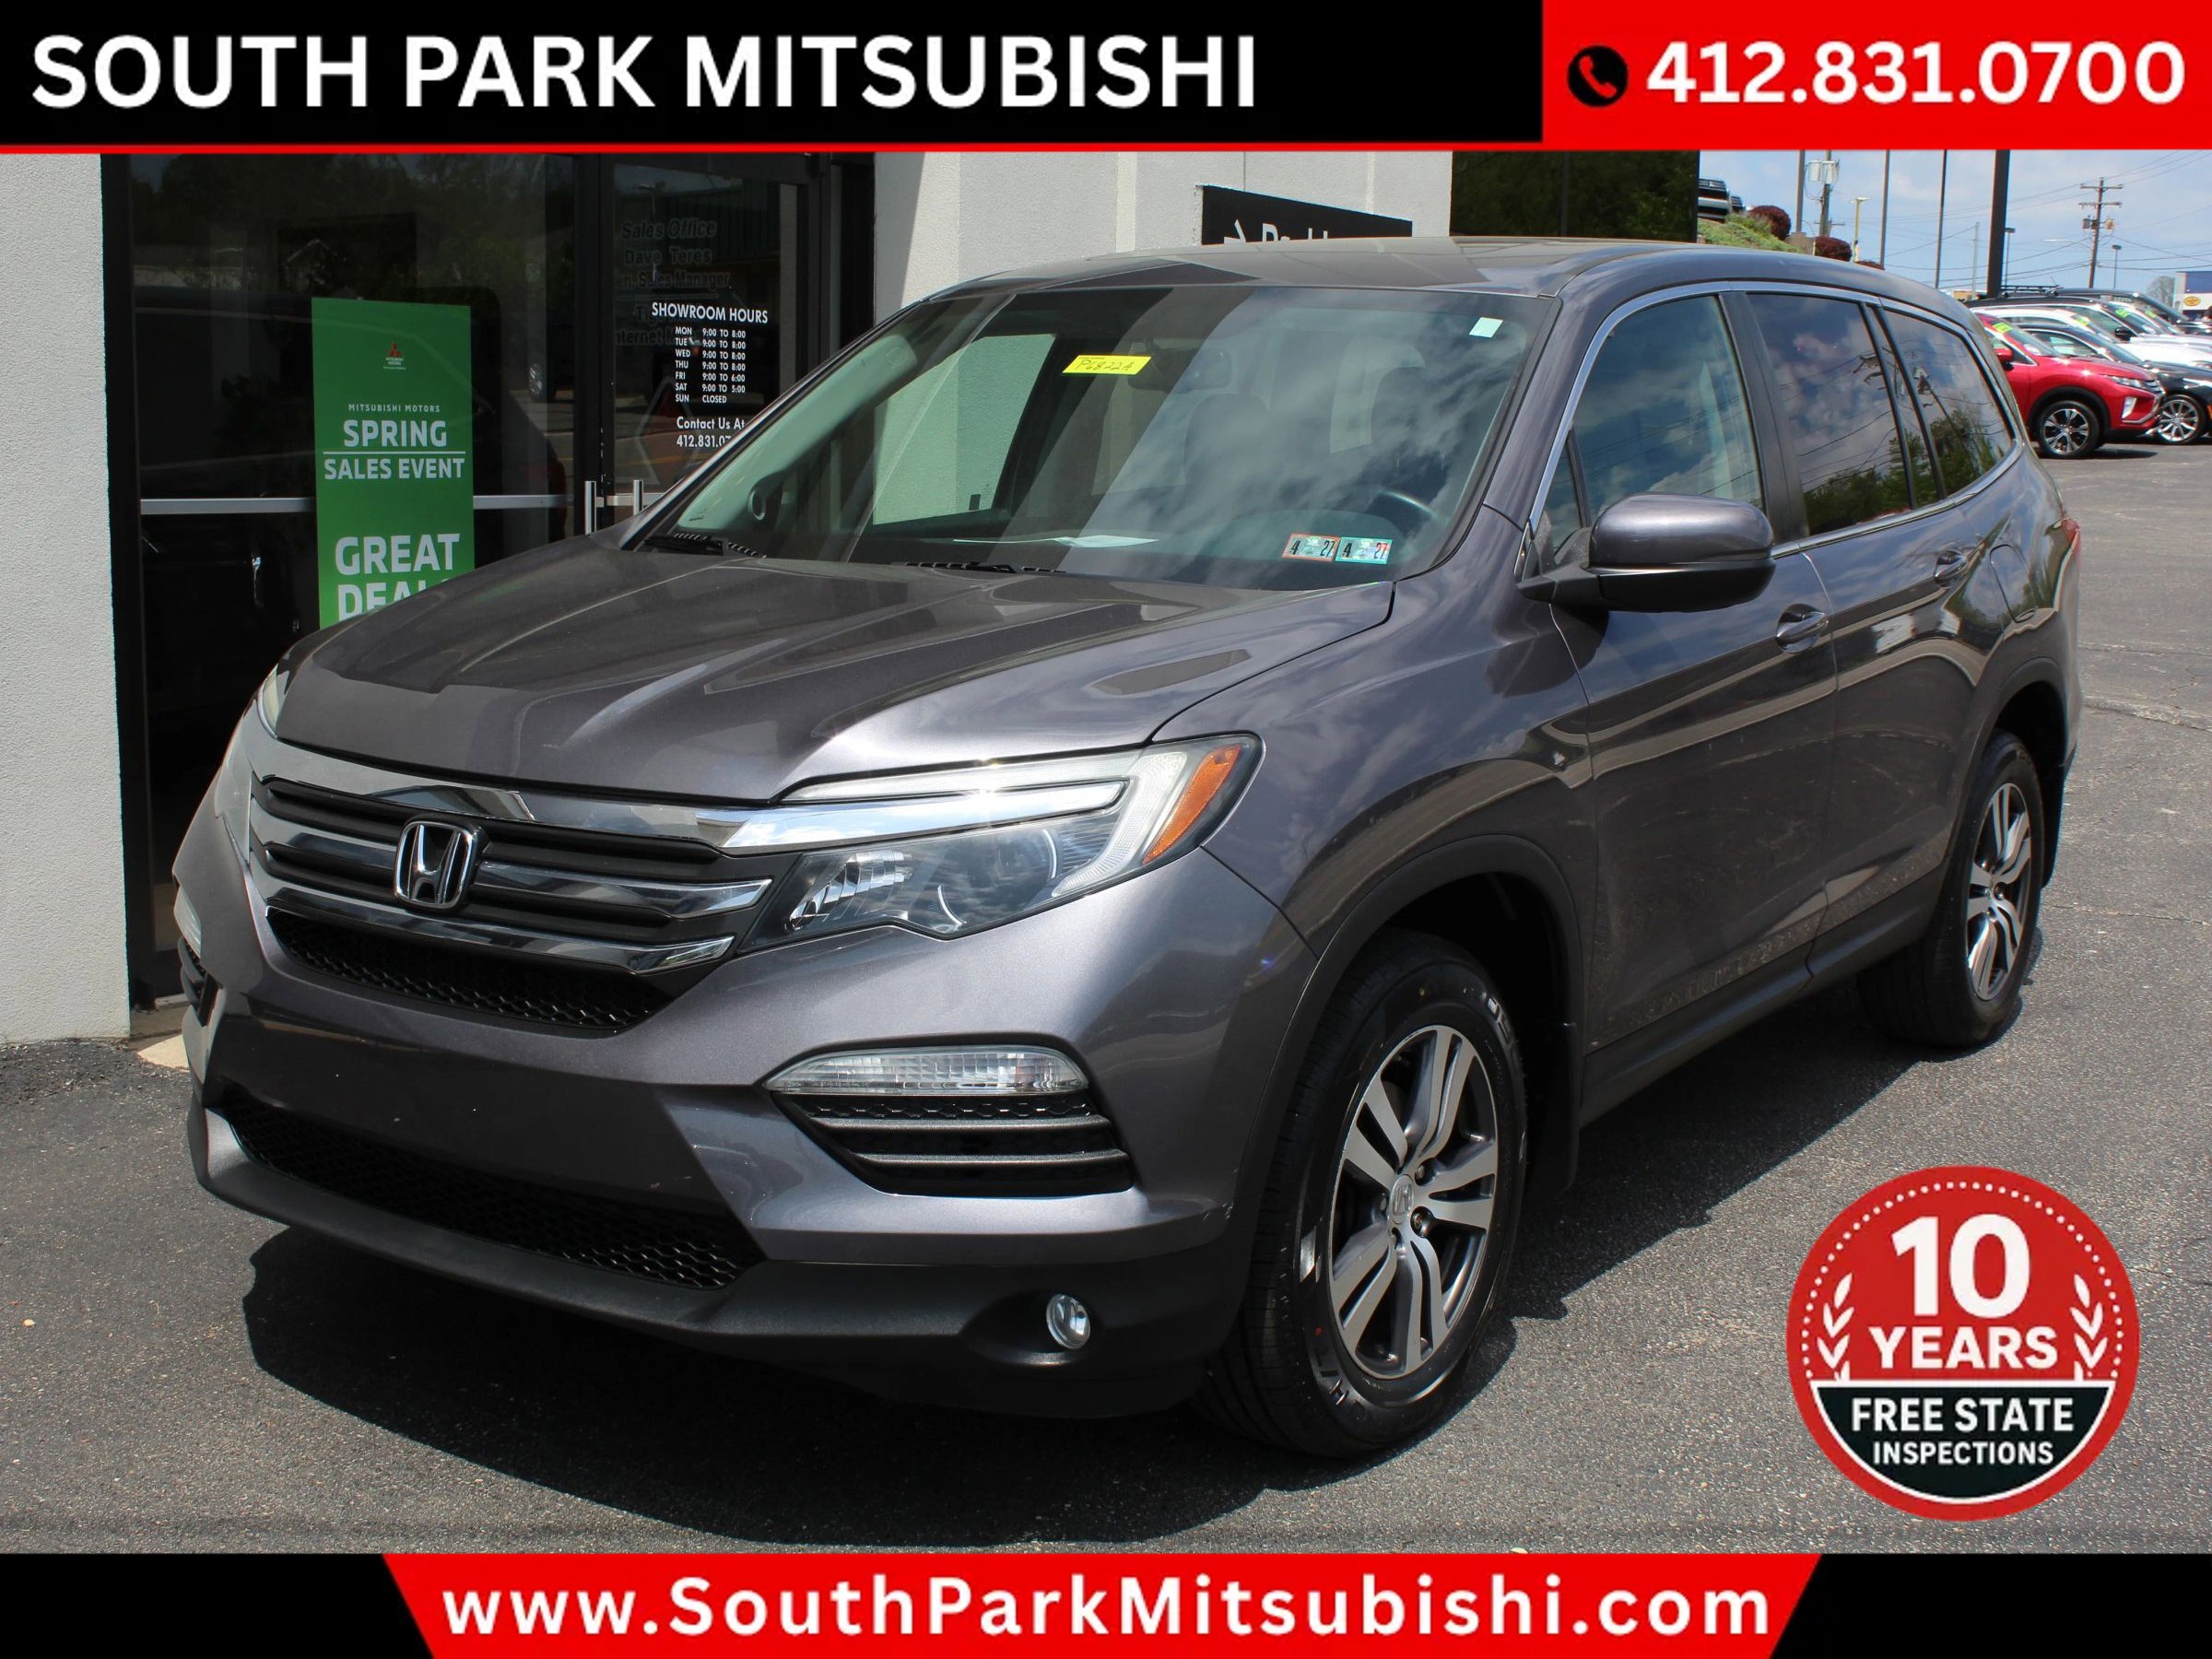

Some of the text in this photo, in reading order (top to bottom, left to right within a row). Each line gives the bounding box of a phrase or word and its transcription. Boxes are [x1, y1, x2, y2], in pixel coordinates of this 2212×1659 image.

[653, 302, 726, 321] SHOWROOM
[729, 308, 769, 324] HOURS
[675, 326, 747, 338] MON 9:00 TO 8:00
[675, 337, 747, 349] TUE 9:00 TO 8:00
[675, 348, 747, 360] WED 9:00 TO 8:00
[675, 360, 747, 371] THU 9:00 TO 8:00
[675, 371, 747, 382] FRI 9:00 TO 6:00
[675, 382, 747, 394] SAT 9:00 TO 5:00
[675, 394, 727, 404] SUN CLOSED
[348, 404, 441, 413] MITSUBISHI MOTORS
[677, 416, 746, 430] Contact Us At
[343, 419, 447, 448] SPRING
[324, 458, 465, 480] SALES EVENT
[335, 533, 461, 576] GREAT
[1290, 540, 1336, 558] 4 27
[1342, 542, 1388, 559] 4 27
